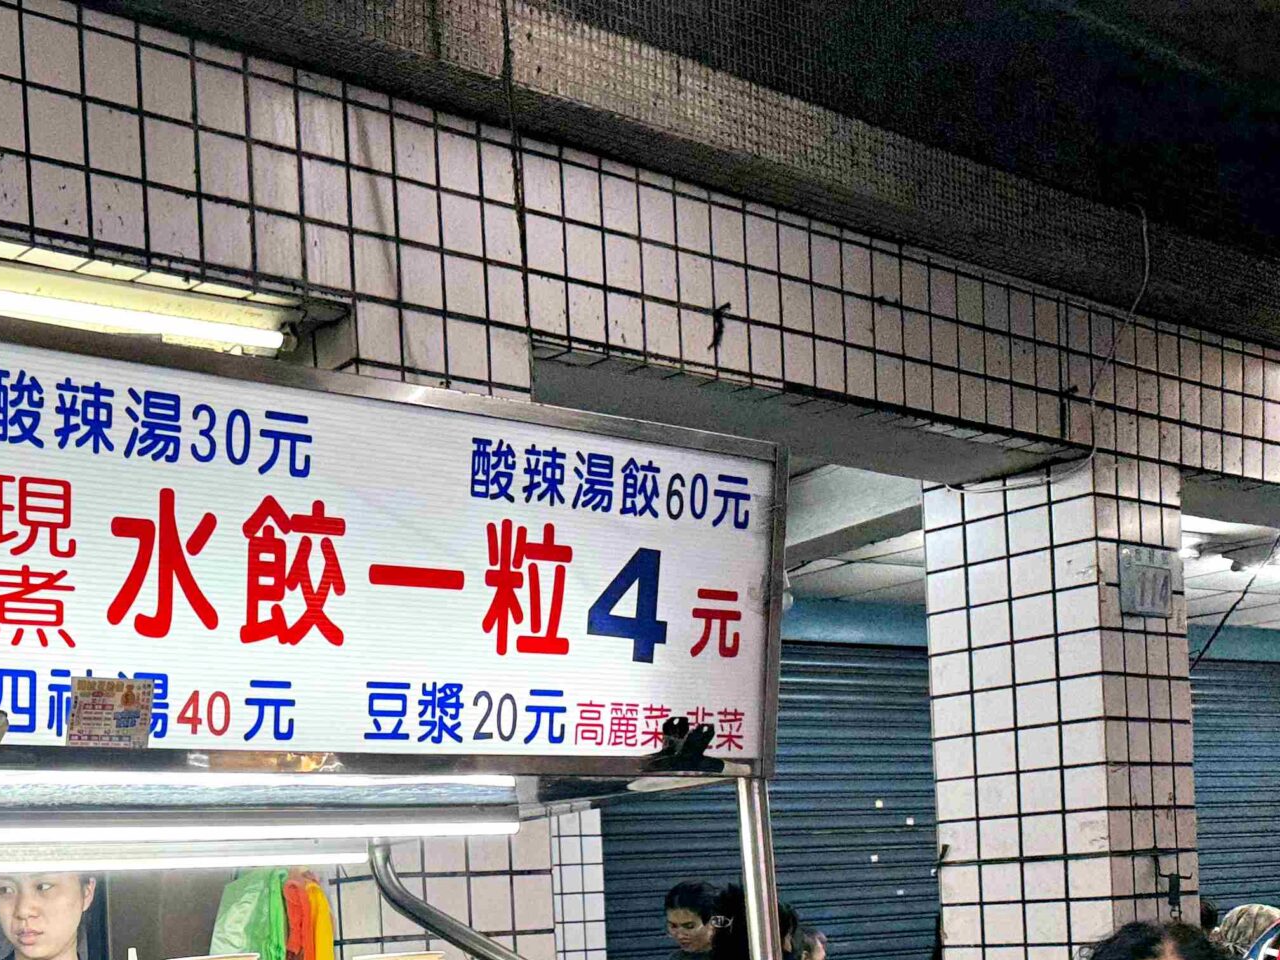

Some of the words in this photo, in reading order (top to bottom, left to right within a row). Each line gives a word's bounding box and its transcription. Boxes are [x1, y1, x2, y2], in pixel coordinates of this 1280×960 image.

[470, 437, 751, 530] 酸辣湯餃60元
[106, 487, 743, 665] 水餃一粒4元
[363, 681, 567, 745] 豆漿20元
[574, 699, 673, 749] 高麗菜
